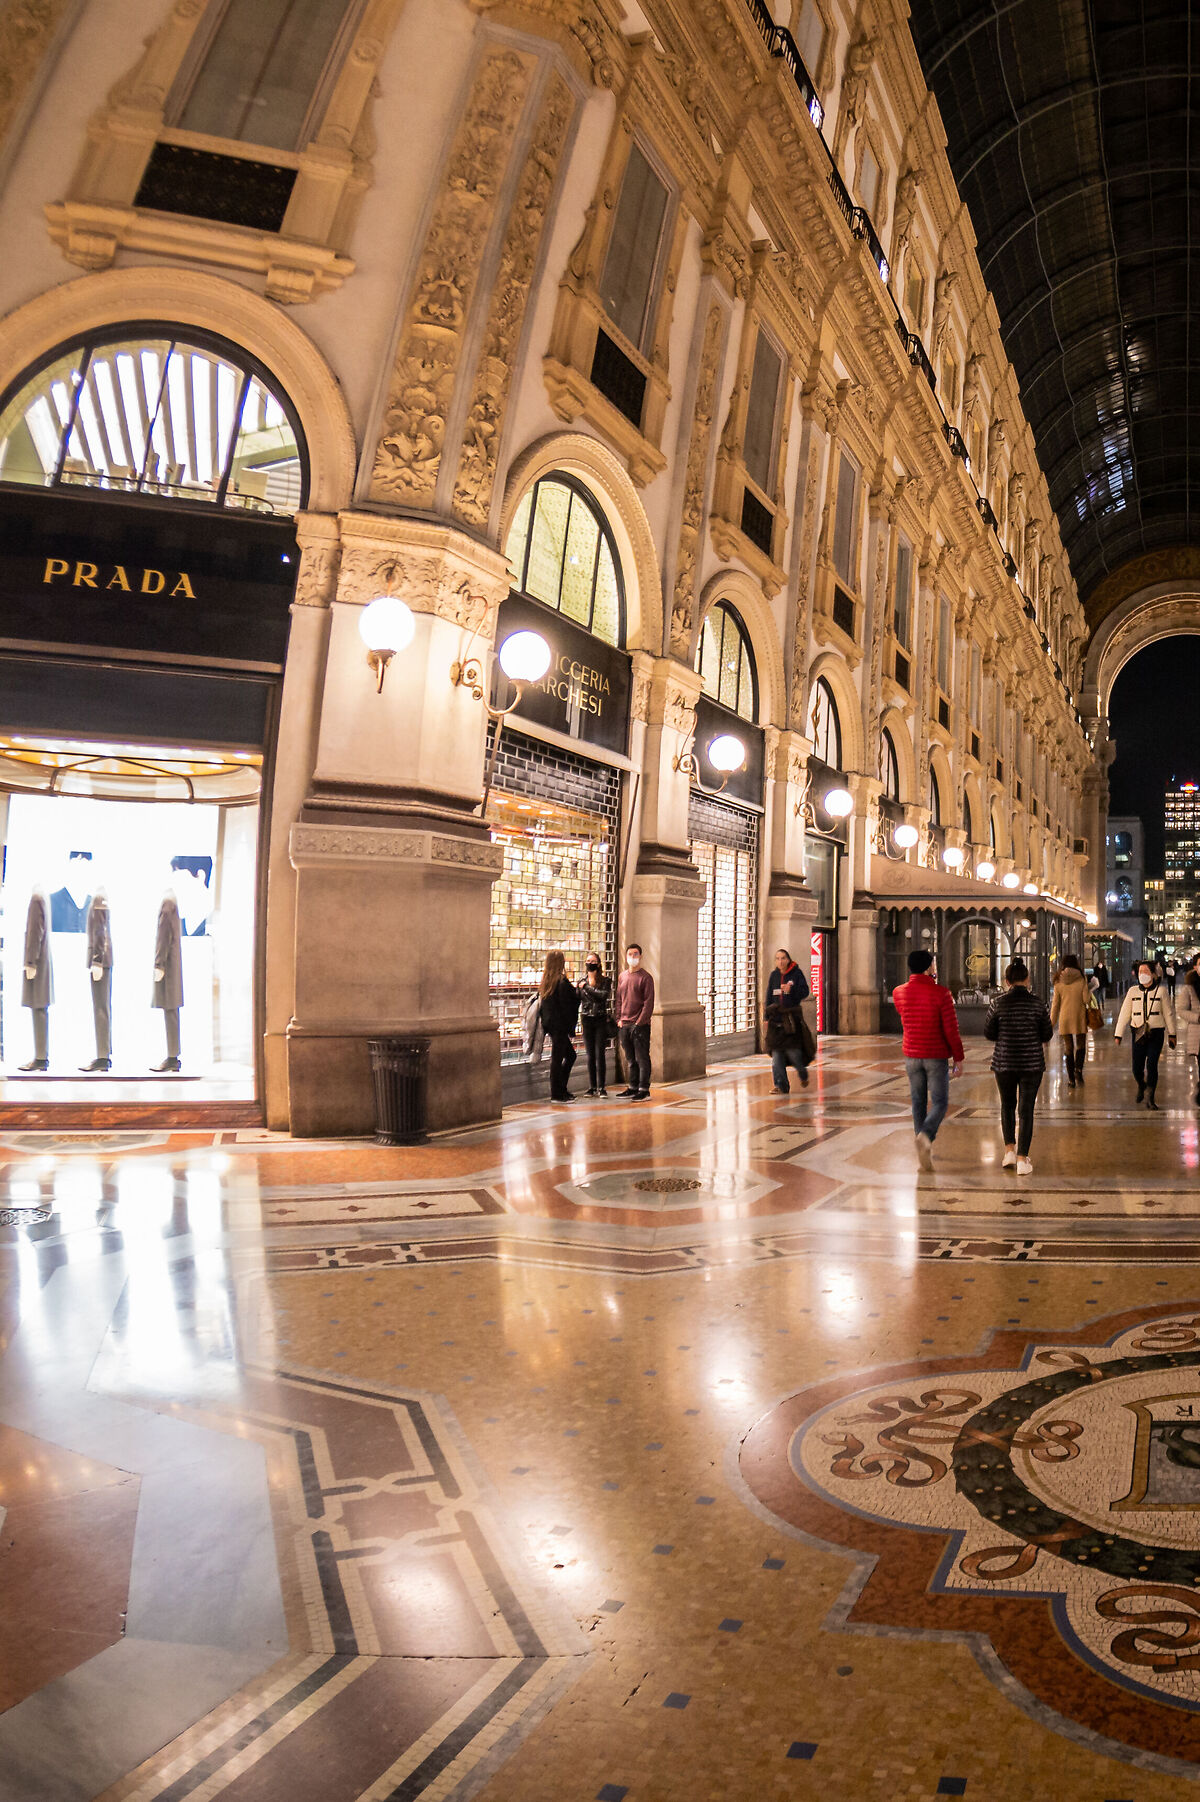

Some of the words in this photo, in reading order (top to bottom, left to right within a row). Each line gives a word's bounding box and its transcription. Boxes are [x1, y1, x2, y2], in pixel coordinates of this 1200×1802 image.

[43, 558, 197, 599] PRADA
[555, 651, 611, 696] ICCERIA
[535, 675, 603, 717] ARCHESI
